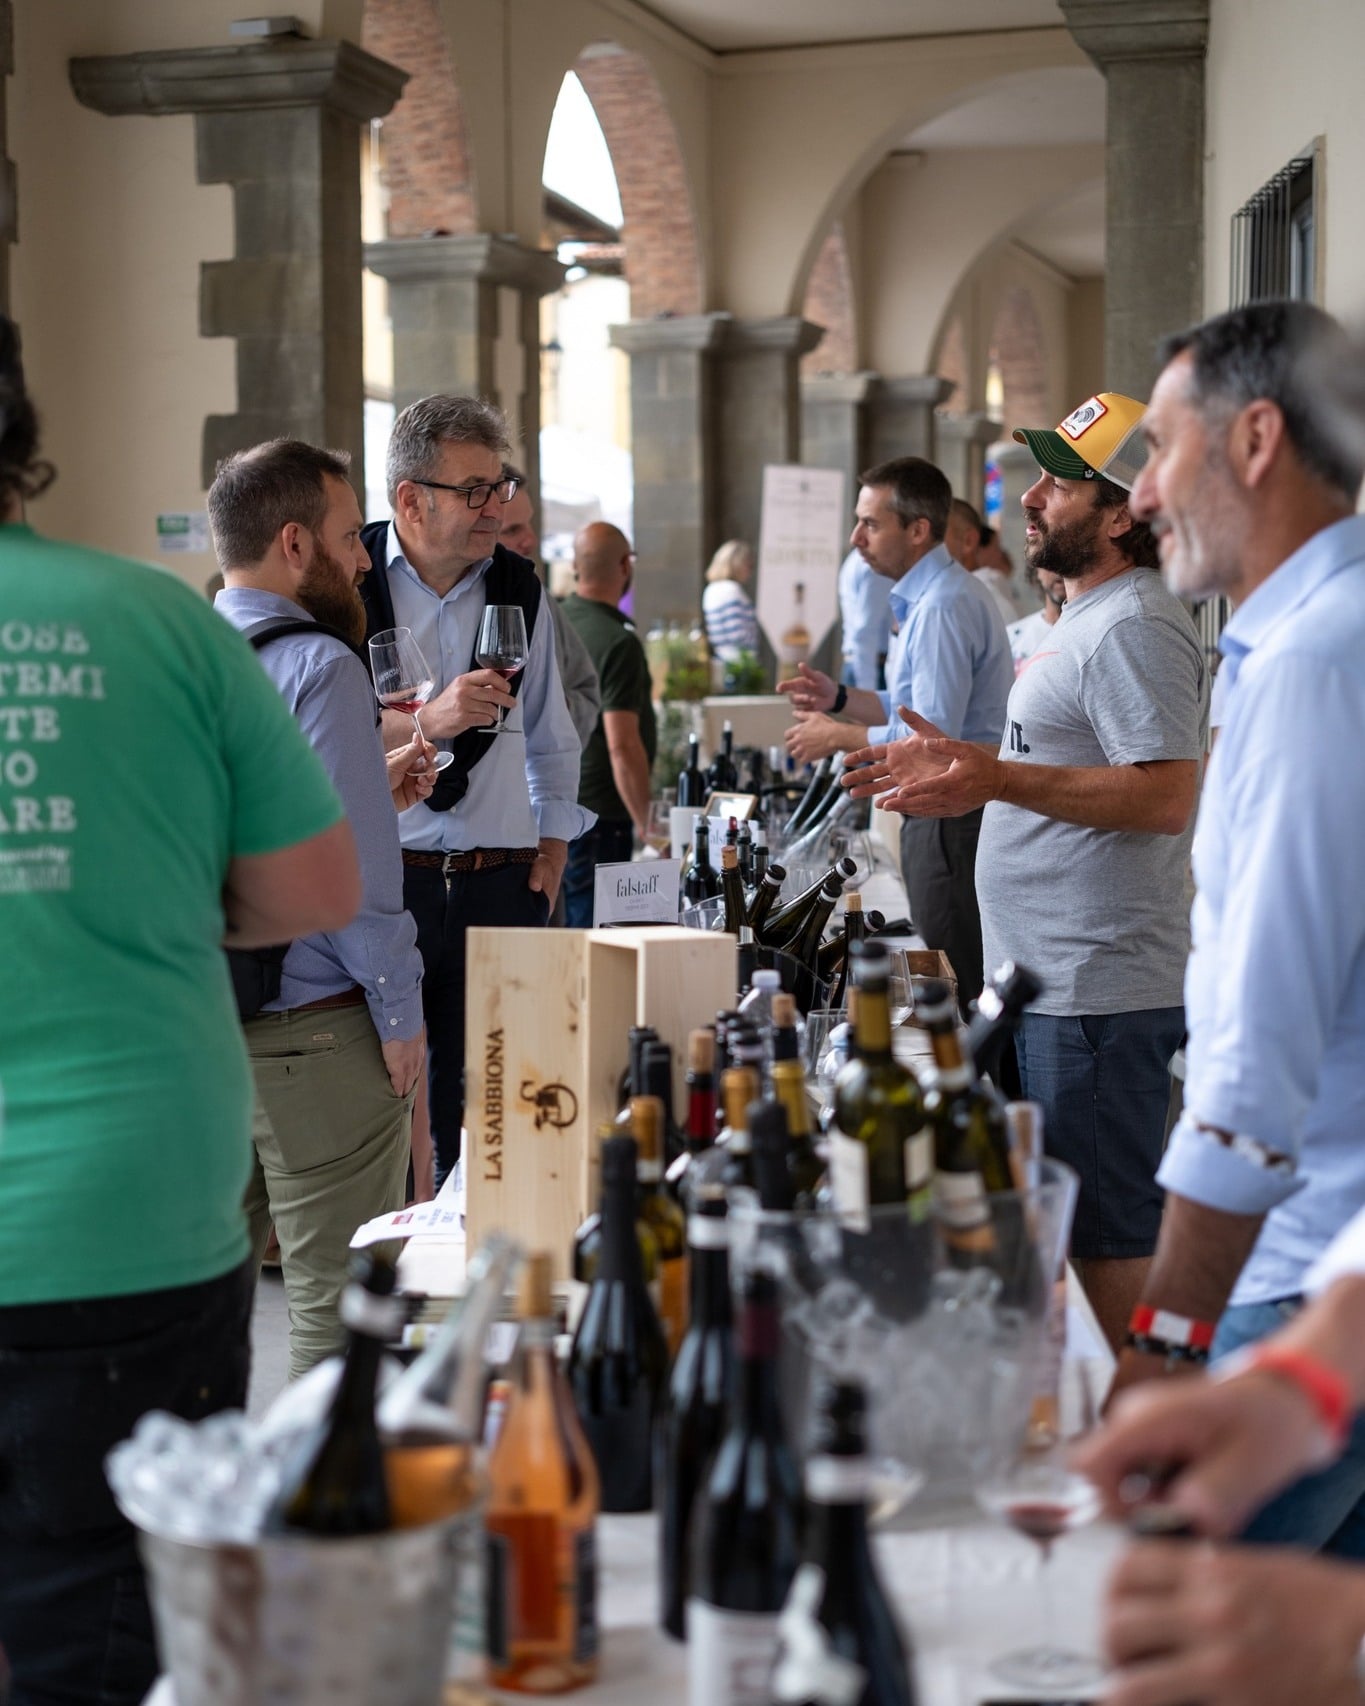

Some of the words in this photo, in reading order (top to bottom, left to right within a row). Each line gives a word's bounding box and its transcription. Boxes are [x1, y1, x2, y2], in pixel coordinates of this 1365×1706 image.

[616, 874, 660, 898] falstaff
[484, 1028, 504, 1146] SABBIONA
[484, 1151, 503, 1182] LA
